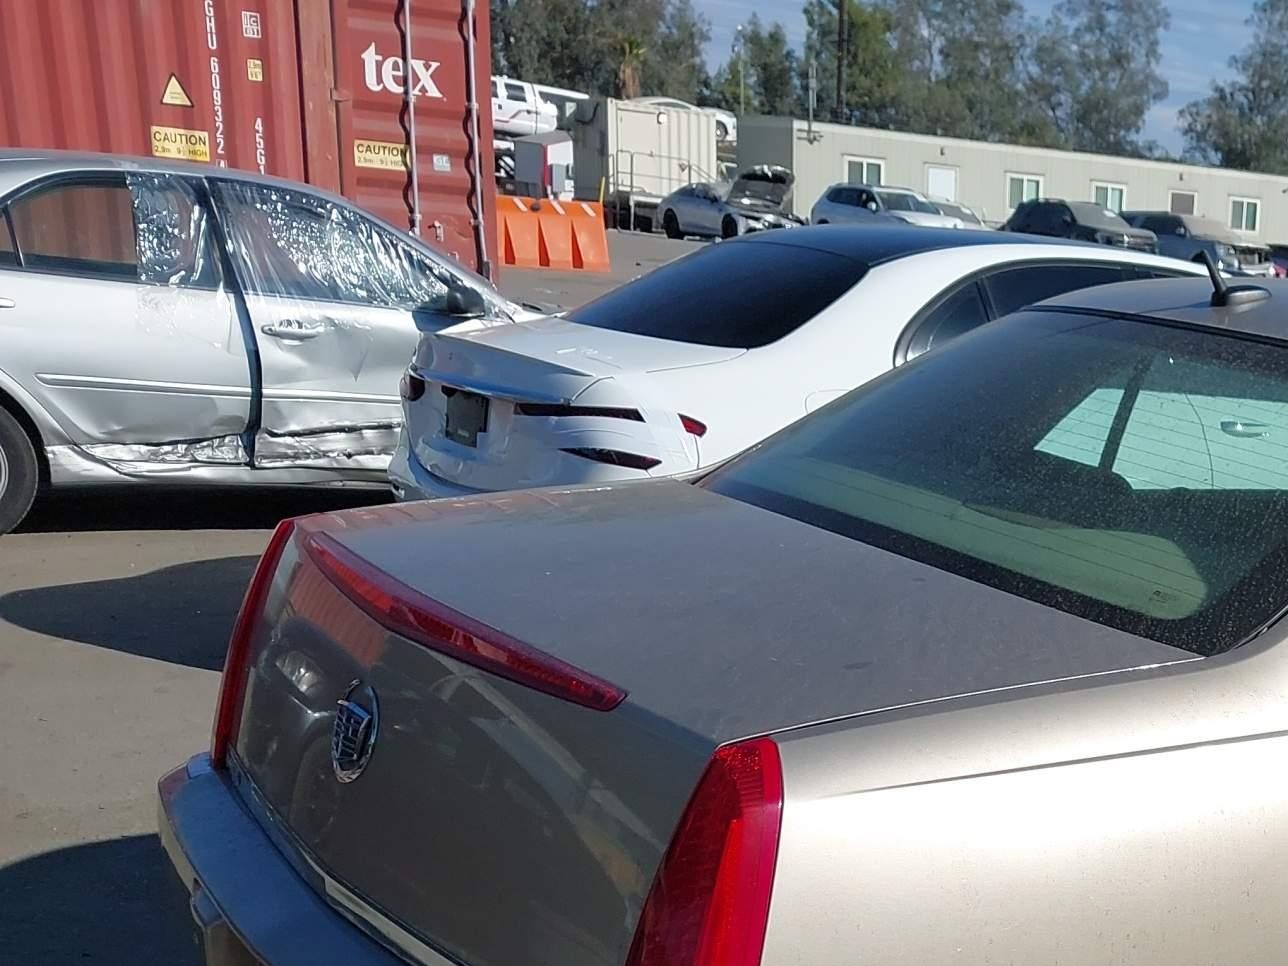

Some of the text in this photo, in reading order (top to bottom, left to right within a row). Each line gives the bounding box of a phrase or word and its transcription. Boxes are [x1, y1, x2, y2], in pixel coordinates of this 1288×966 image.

[361, 42, 443, 98] tex
[210, 57, 225, 154] 609322
[153, 130, 206, 147] CAUTION
[356, 143, 408, 159] CAUTION
